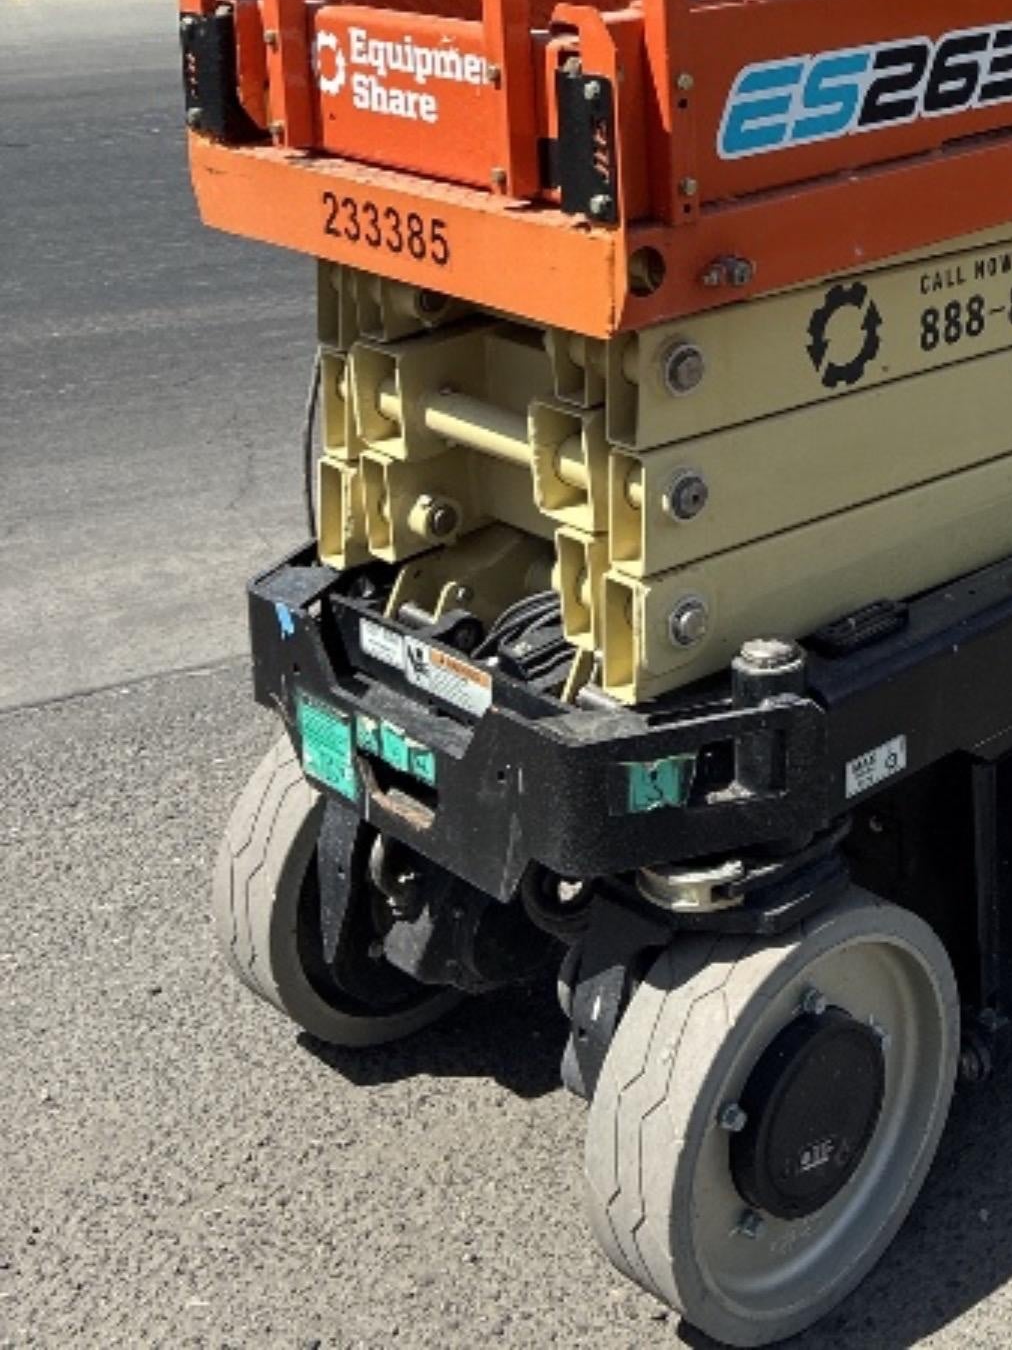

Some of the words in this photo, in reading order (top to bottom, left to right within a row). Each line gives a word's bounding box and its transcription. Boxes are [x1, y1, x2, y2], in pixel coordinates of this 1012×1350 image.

[347, 25, 490, 85] Equipme
[351, 72, 439, 124] Share
[321, 190, 450, 266] 233385
[919, 270, 966, 295] CALL
[975, 252, 1012, 280] NOW
